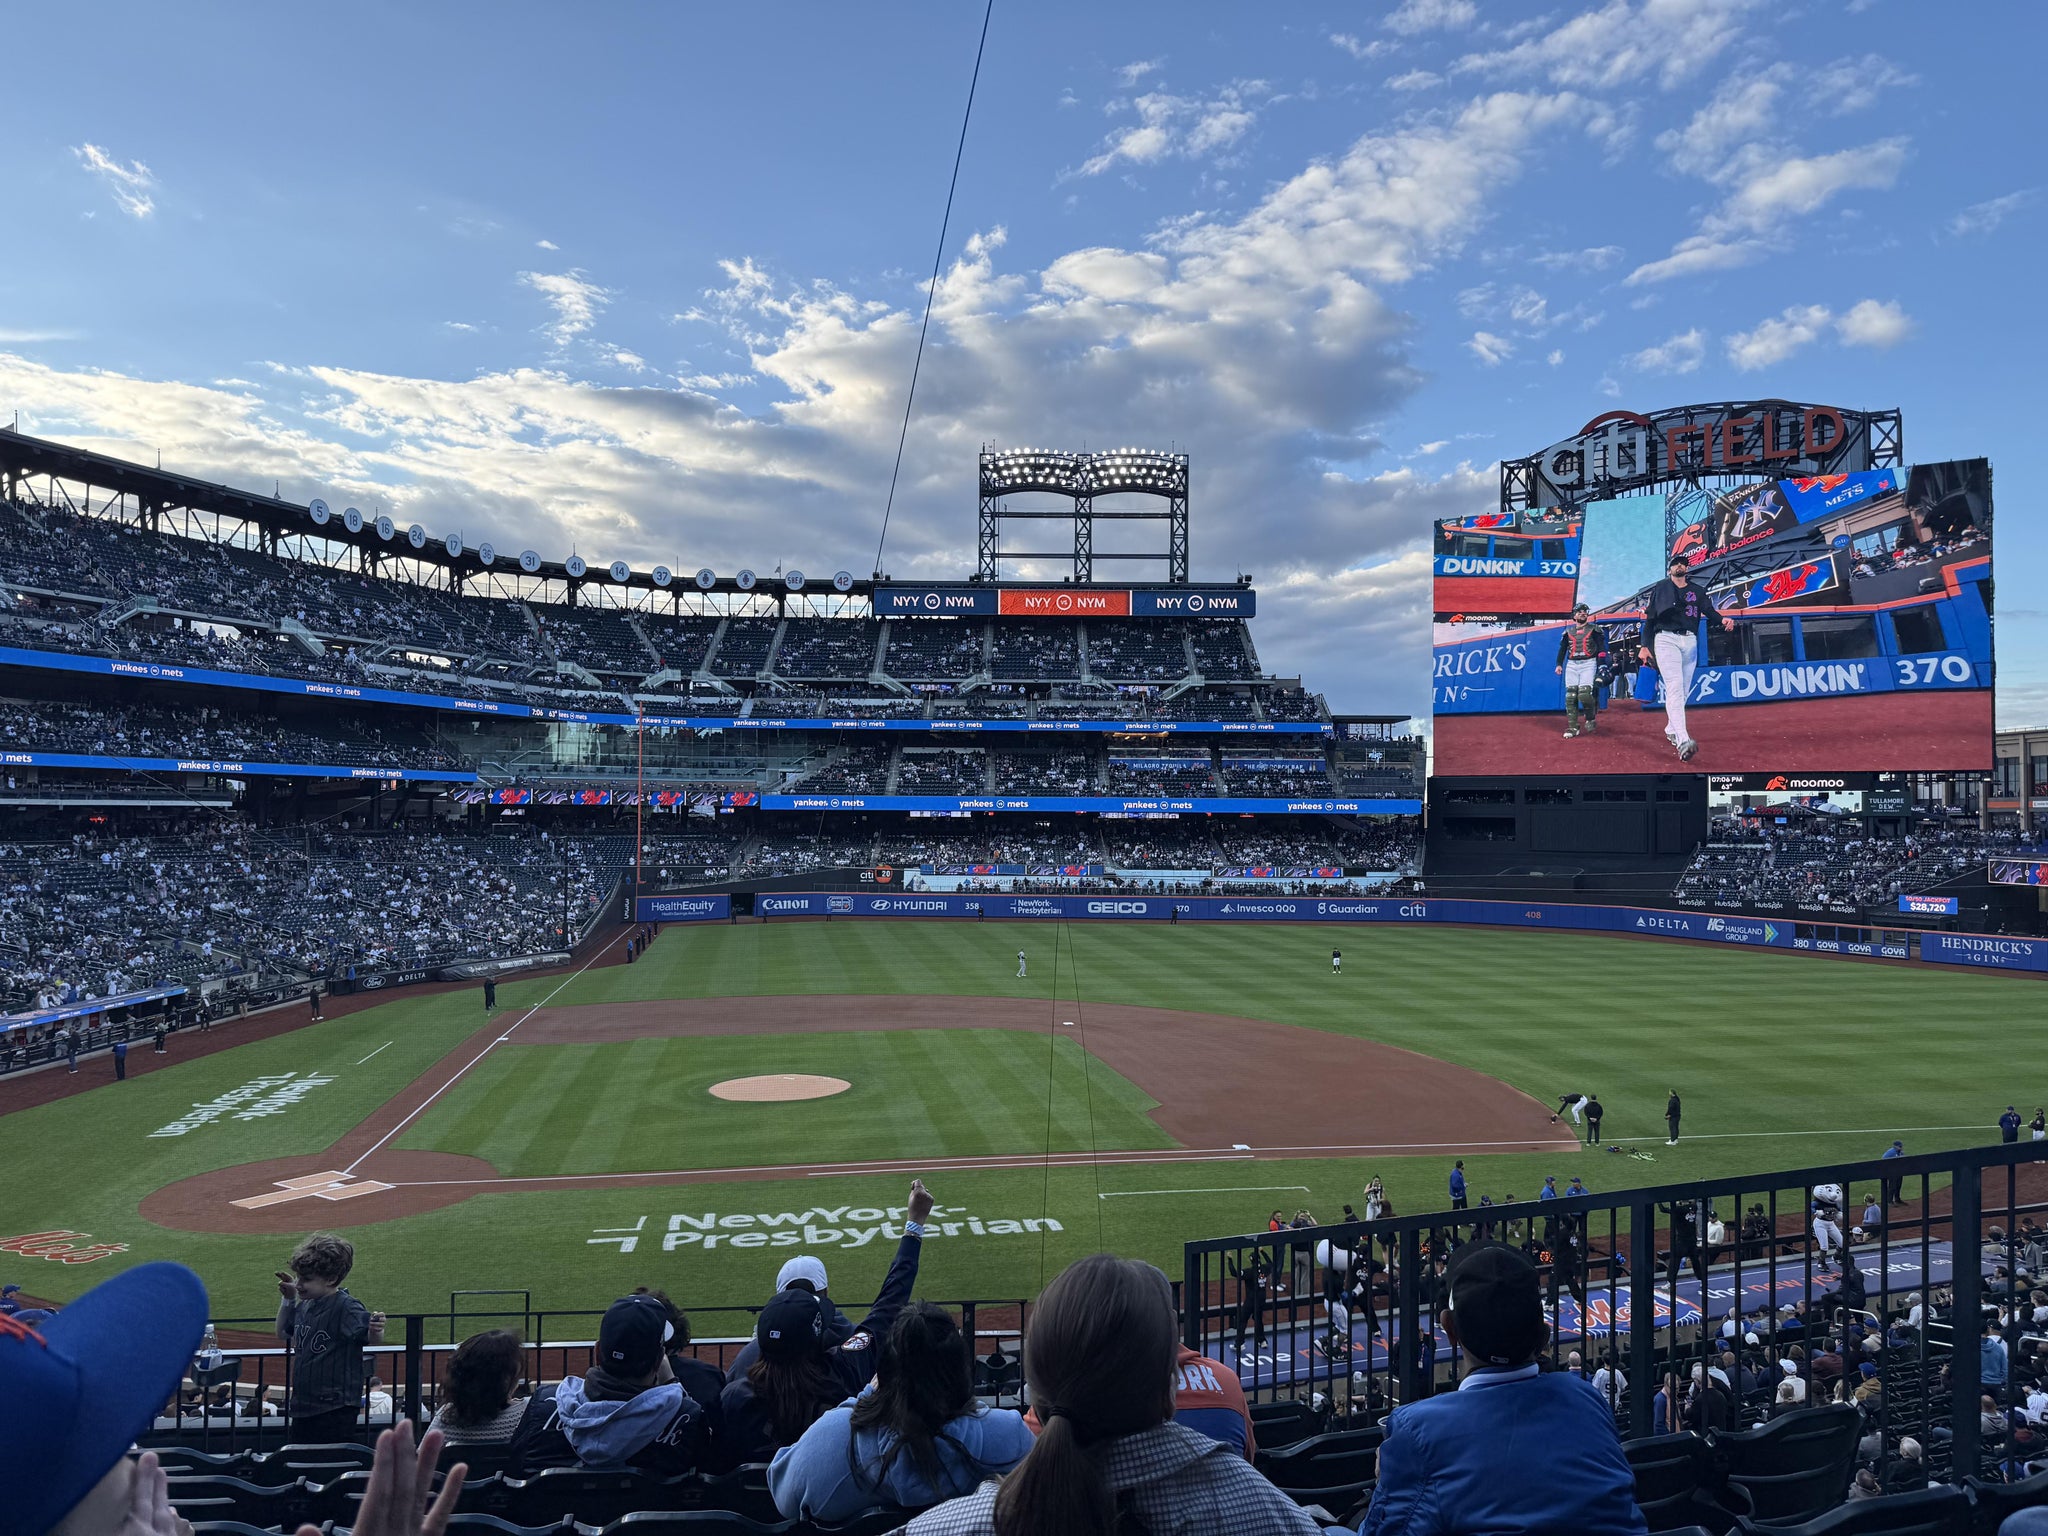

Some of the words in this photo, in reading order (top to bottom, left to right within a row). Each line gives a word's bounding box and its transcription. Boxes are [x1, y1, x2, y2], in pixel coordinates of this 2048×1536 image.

[1542, 422, 1646, 485] citi
[1667, 407, 1845, 471] FIELD
[1826, 487, 1864, 508] METS
[316, 506, 324, 518] 5
[349, 514, 358, 526] 18
[381, 523, 390, 534] 16
[412, 530, 422, 542] 24
[450, 540, 458, 551] 17
[1709, 545, 1729, 558] new
[1730, 527, 1775, 552] balance
[482, 548, 492, 559] 36
[525, 556, 535, 566] 31
[570, 562, 580, 572] 41
[615, 567, 624, 577] 14
[1443, 559, 1525, 575] DUNKIN'
[1540, 562, 1577, 575] 370
[656, 571, 668, 582] 37
[837, 576, 850, 586] 42
[893, 596, 920, 607] NYY
[946, 596, 974, 608] NYM
[1024, 597, 1051, 608] NYY
[1078, 598, 1106, 608] NYM
[1156, 598, 1183, 609] NYY
[1209, 598, 1238, 609] NYM
[1433, 643, 1527, 678] RICK'S
[111, 662, 148, 674] yankees
[162, 668, 184, 678] mets
[1730, 663, 1864, 698] DUNKIN'
[1895, 656, 1971, 685] 370
[306, 684, 334, 694] yankees
[344, 688, 360, 696] mets
[454, 700, 477, 710] yankees
[532, 708, 544, 717] 7:06
[6, 753, 32, 764] mets
[177, 760, 210, 772] yankees
[222, 762, 243, 772] mets
[351, 768, 378, 778] yankees
[386, 770, 402, 778] mets
[1790, 778, 1844, 788] moomoo
[793, 800, 828, 808] yankees
[842, 799, 865, 808] mets
[958, 800, 994, 809] yankees
[1006, 800, 1029, 808] mets
[1122, 802, 1158, 810] yankees
[1170, 802, 1193, 810] mets
[1288, 802, 1322, 811] yankees
[1336, 802, 1358, 810] mets
[860, 872, 874, 880] citi
[881, 870, 891, 878] 20
[651, 901, 716, 912] HealthEquity
[762, 898, 808, 910] Canon
[893, 900, 947, 910] HYUNDAI
[964, 902, 980, 910] 358
[1018, 900, 1052, 908] NewYork-
[1088, 902, 1147, 914] GEICO
[1678, 899, 1706, 907] HubSpot
[1714, 900, 1743, 908] HubSpot
[1754, 901, 1784, 910] HubSpot
[1798, 902, 1824, 912] HubSpot
[1910, 902, 1946, 913] $28,720
[1018, 906, 1062, 915] Presbyterian
[1236, 904, 1274, 913] Invesco
[1276, 904, 1296, 914] QQQ
[1329, 904, 1378, 914] Guardian
[1400, 904, 1426, 917] citi
[1829, 905, 1856, 914] HubSpot
[1524, 910, 1542, 920] 408
[1648, 917, 1690, 931] DELTA
[1725, 926, 1762, 936] HAUGLAND
[1725, 932, 1748, 942] GROUP
[1793, 938, 1809, 948] 380
[1816, 940, 1839, 950] GOYA
[1942, 937, 2033, 955] HENDRICK'S
[1848, 944, 1872, 953] GOYA
[1881, 946, 1906, 956] GOYA
[1974, 954, 2000, 963] GIN
[404, 972, 426, 981] DELTA
[366, 976, 383, 988] Ford
[662, 1216, 1064, 1251] Presbyterian
